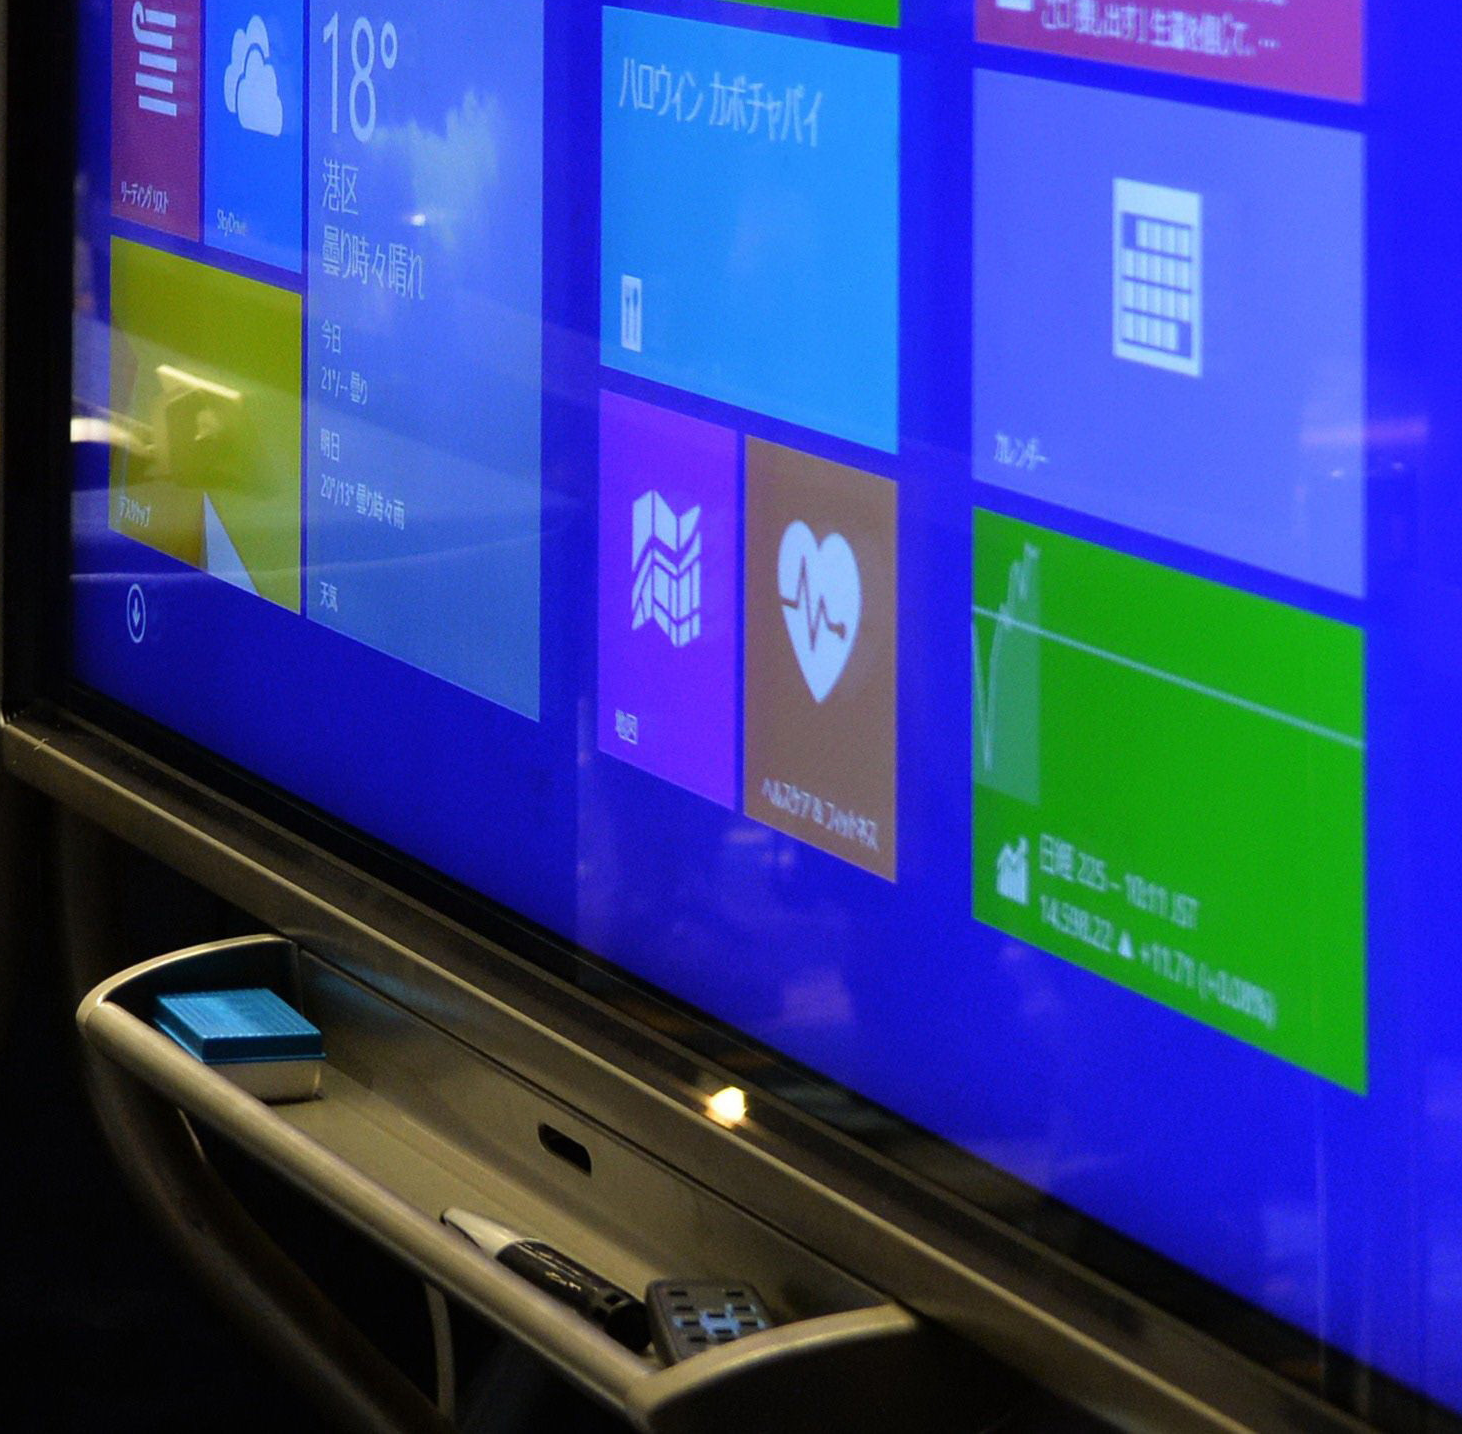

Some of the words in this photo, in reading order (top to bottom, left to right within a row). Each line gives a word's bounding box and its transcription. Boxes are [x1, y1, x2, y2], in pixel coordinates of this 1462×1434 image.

[619, 56, 704, 122] ハロウィン
[323, 158, 359, 216] 港区
[323, 224, 424, 299] 曇り時々晴れ
[321, 320, 341, 355] 今日
[320, 428, 340, 461] 明日
[356, 483, 405, 531] 曇り時々雨
[320, 581, 338, 613] 天気
